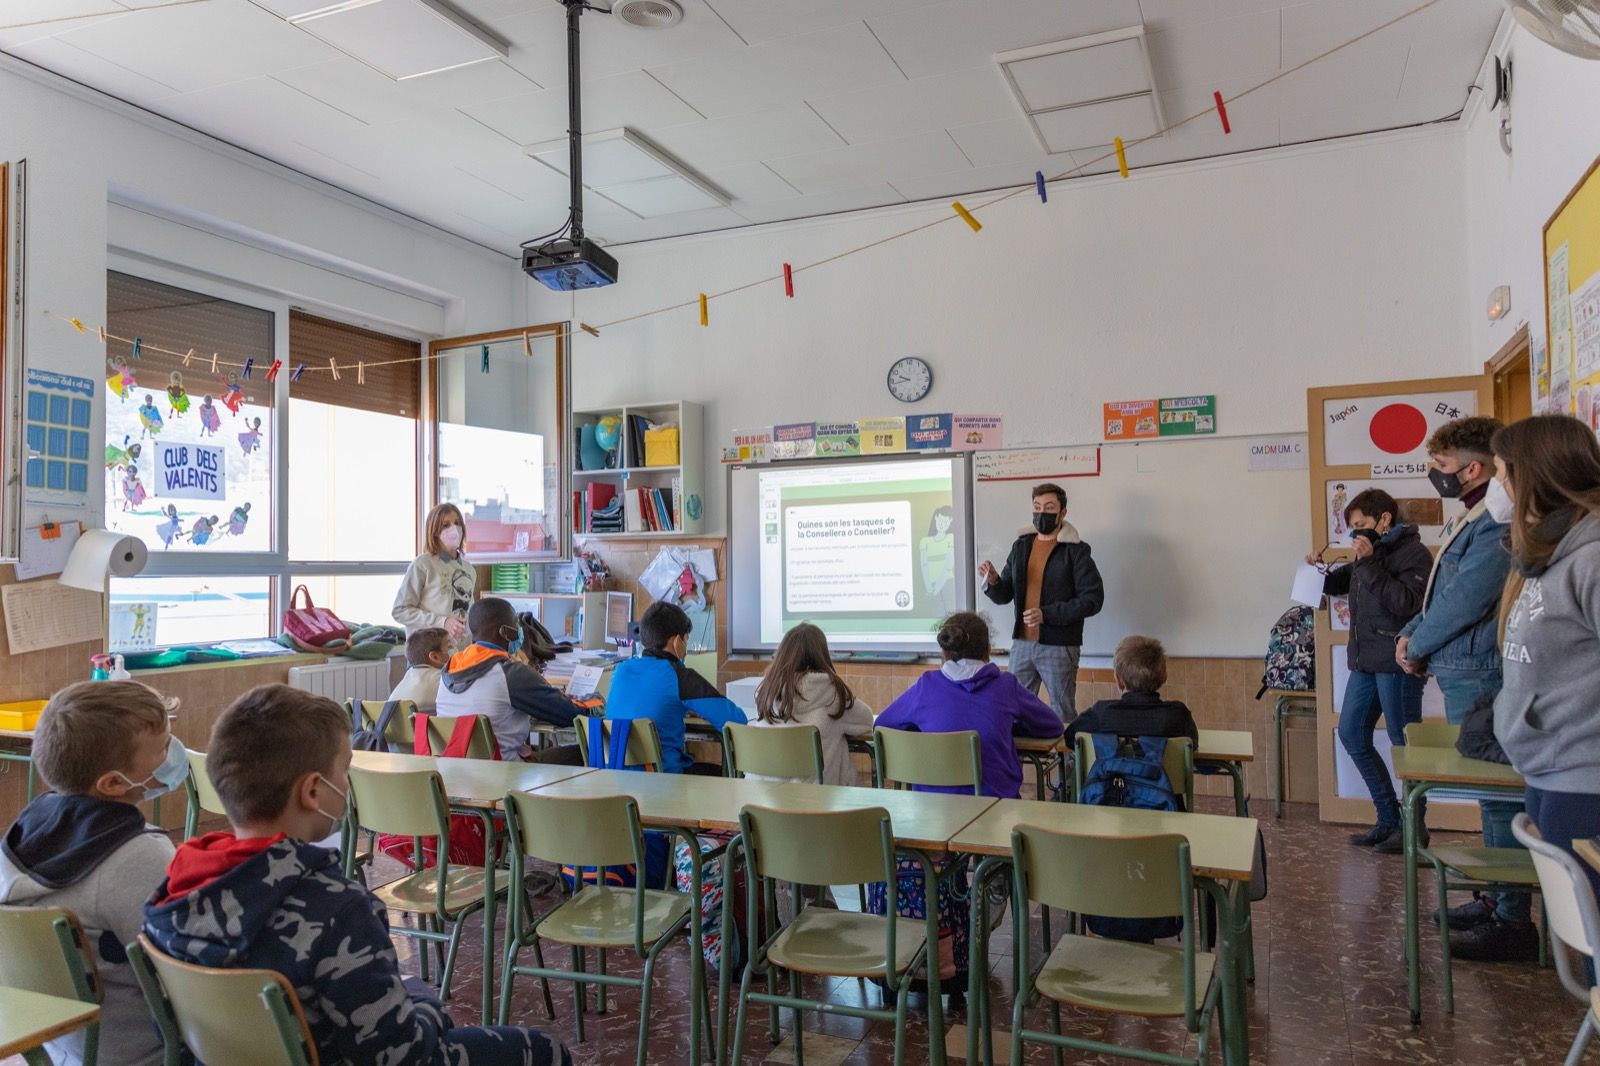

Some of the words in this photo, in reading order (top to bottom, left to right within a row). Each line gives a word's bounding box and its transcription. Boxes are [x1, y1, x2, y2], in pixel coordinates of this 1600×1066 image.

[1329, 403, 1358, 424] Japón
[1434, 402, 1460, 418] 日本
[164, 447, 188, 468] CLUB
[197, 448, 217, 471] DELS
[1373, 464, 1426, 474] こんにちは
[165, 468, 217, 493] VALENTS
[798, 520, 823, 530] Quines
[840, 520, 851, 528] les
[852, 518, 884, 528] tasques
[885, 517, 895, 525] de
[798, 530, 805, 538] la
[806, 529, 846, 538] Consellera
[854, 527, 896, 536] Conseller?
